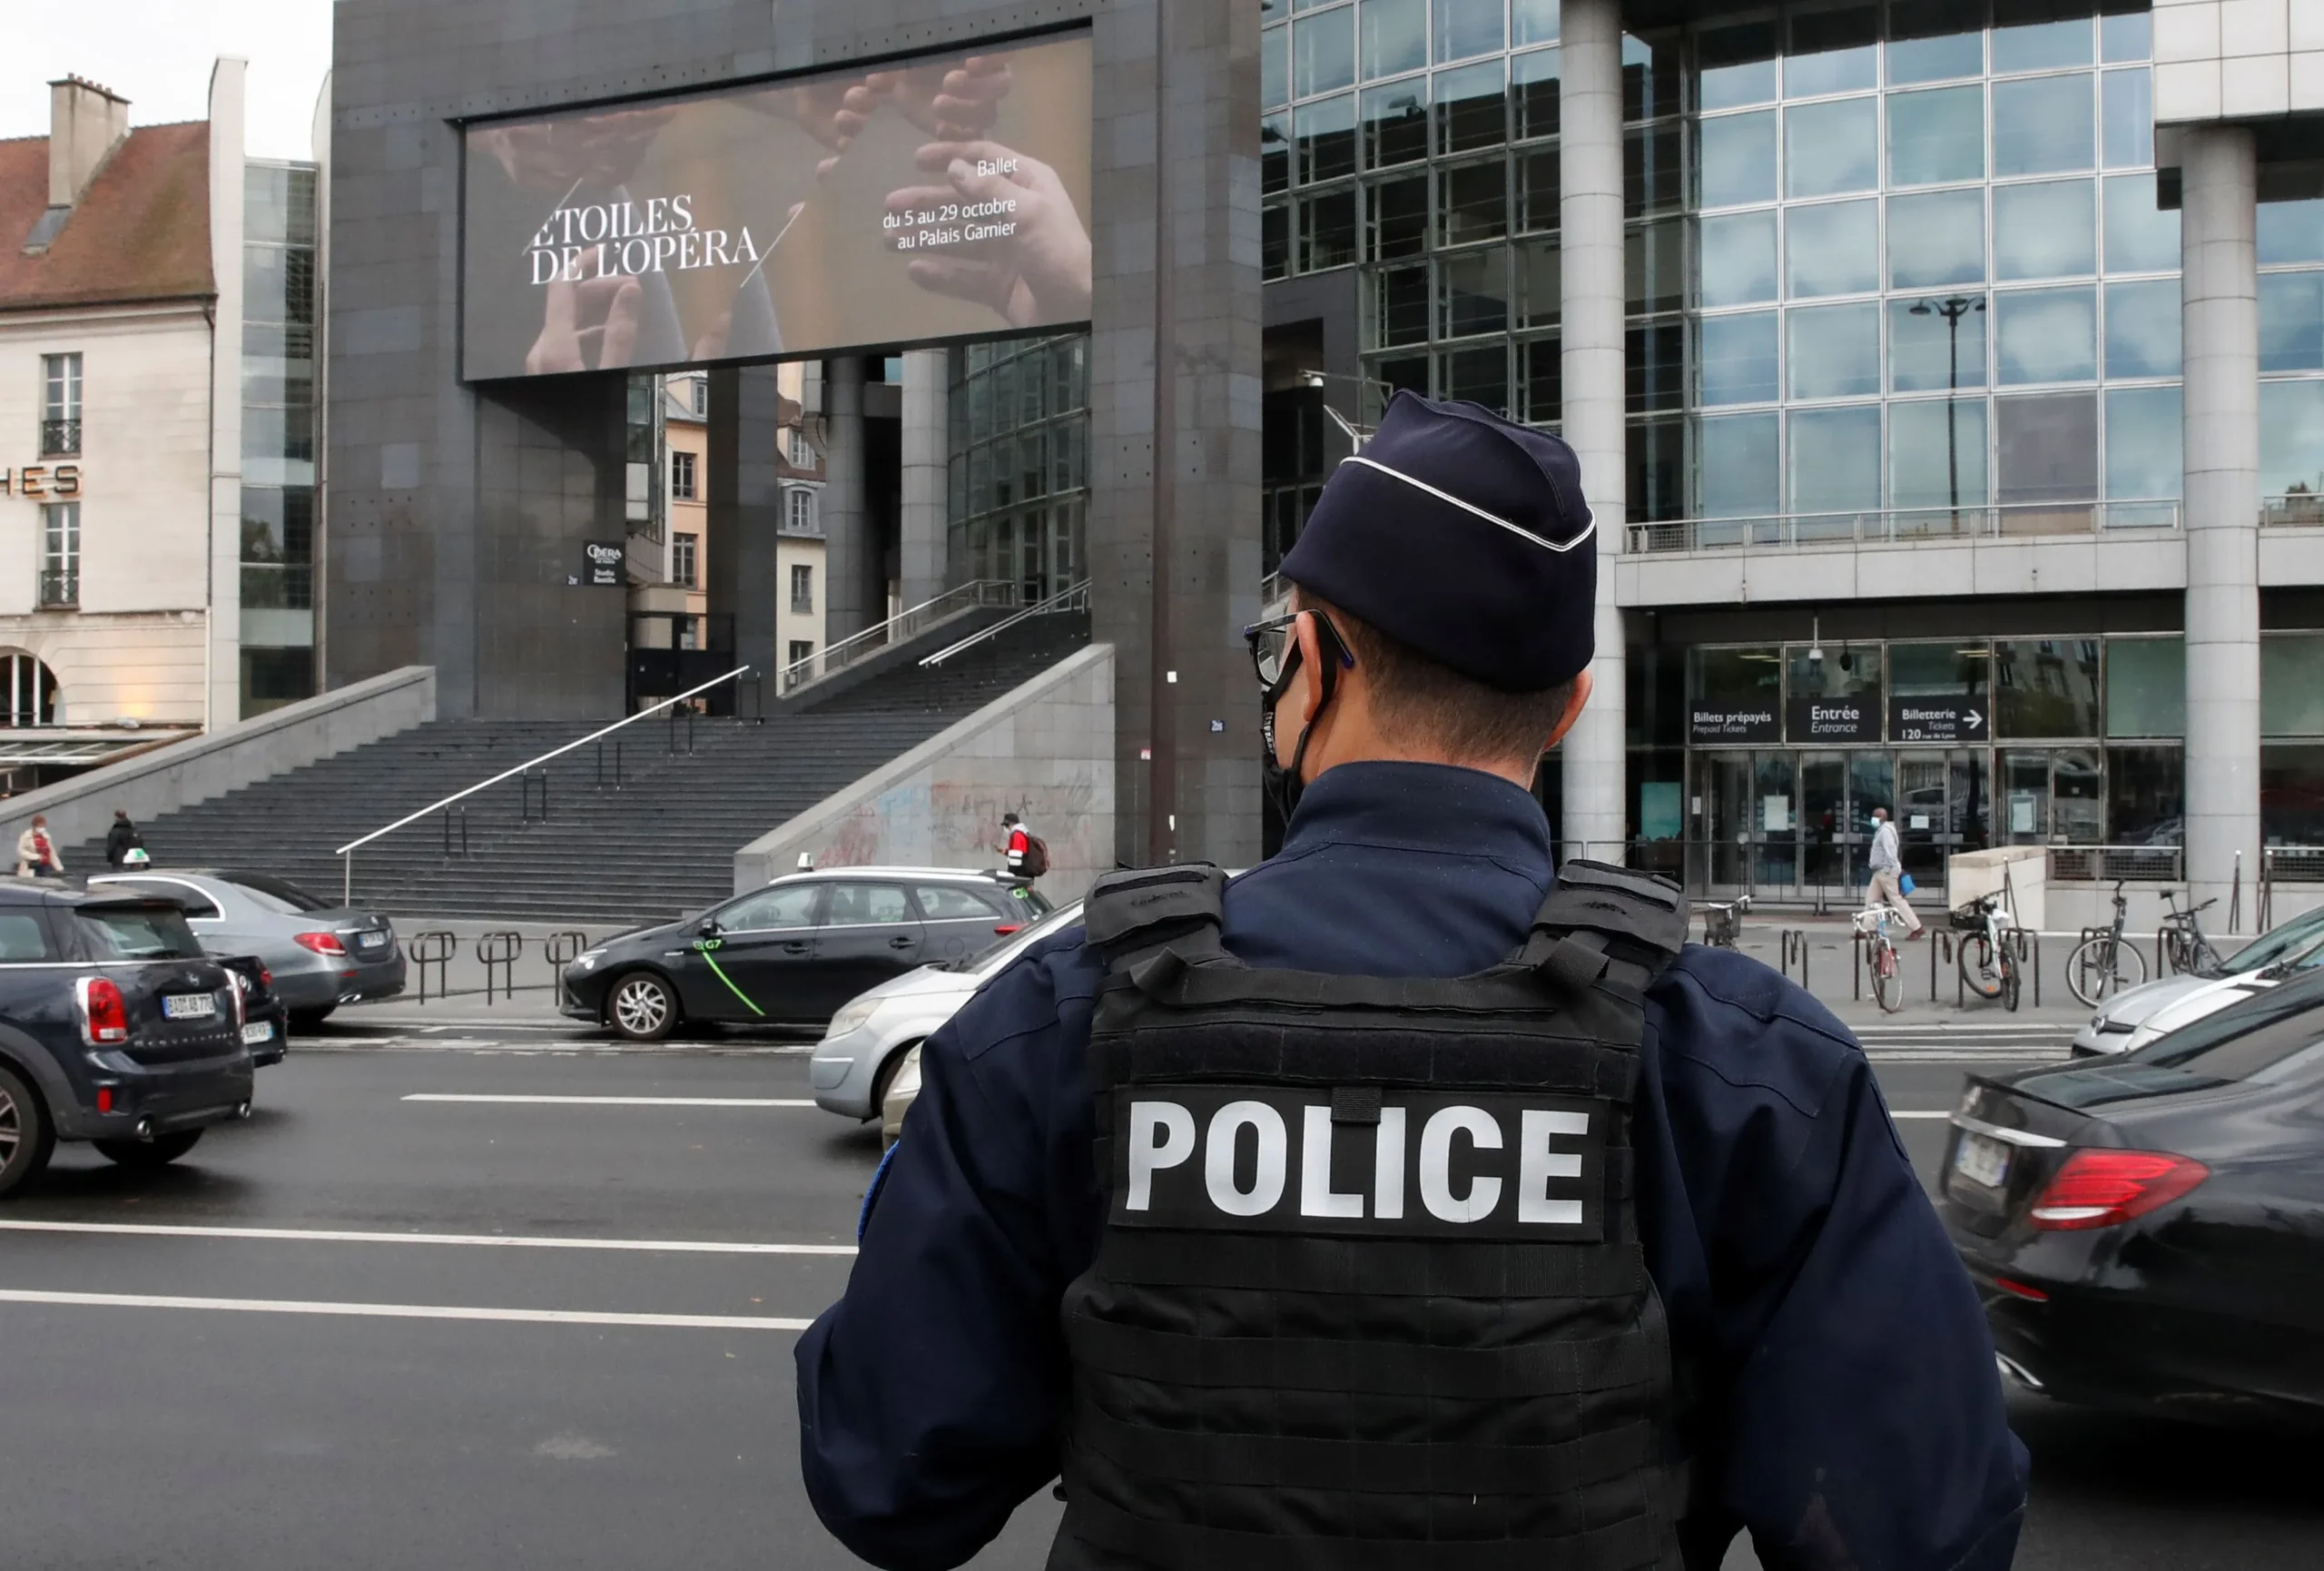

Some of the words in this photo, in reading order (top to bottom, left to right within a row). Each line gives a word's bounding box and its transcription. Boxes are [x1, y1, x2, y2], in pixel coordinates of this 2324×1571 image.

[977, 157, 1019, 177] Ballet
[882, 212, 901, 228] du
[904, 210, 913, 226] 5
[918, 210, 935, 224] au
[939, 204, 958, 222] 29
[962, 197, 1017, 218] octobre
[897, 236, 915, 249] au
[919, 228, 960, 246] Palais
[964, 221, 1017, 241] Garnier
[530, 246, 583, 285] DE
[1694, 712, 1723, 723] Billets
[1726, 711, 1771, 725] prépayés
[1811, 705, 1860, 720] Entrée
[1902, 706, 1956, 720] Billetterie
[1722, 725, 1747, 733] Tickets
[1811, 721, 1857, 734] Entrance
[1928, 721, 1955, 730] Tickets
[1902, 729, 1922, 739] 120
[705, 939, 722, 949] G7
[1126, 1100, 1590, 1224] POLICE
